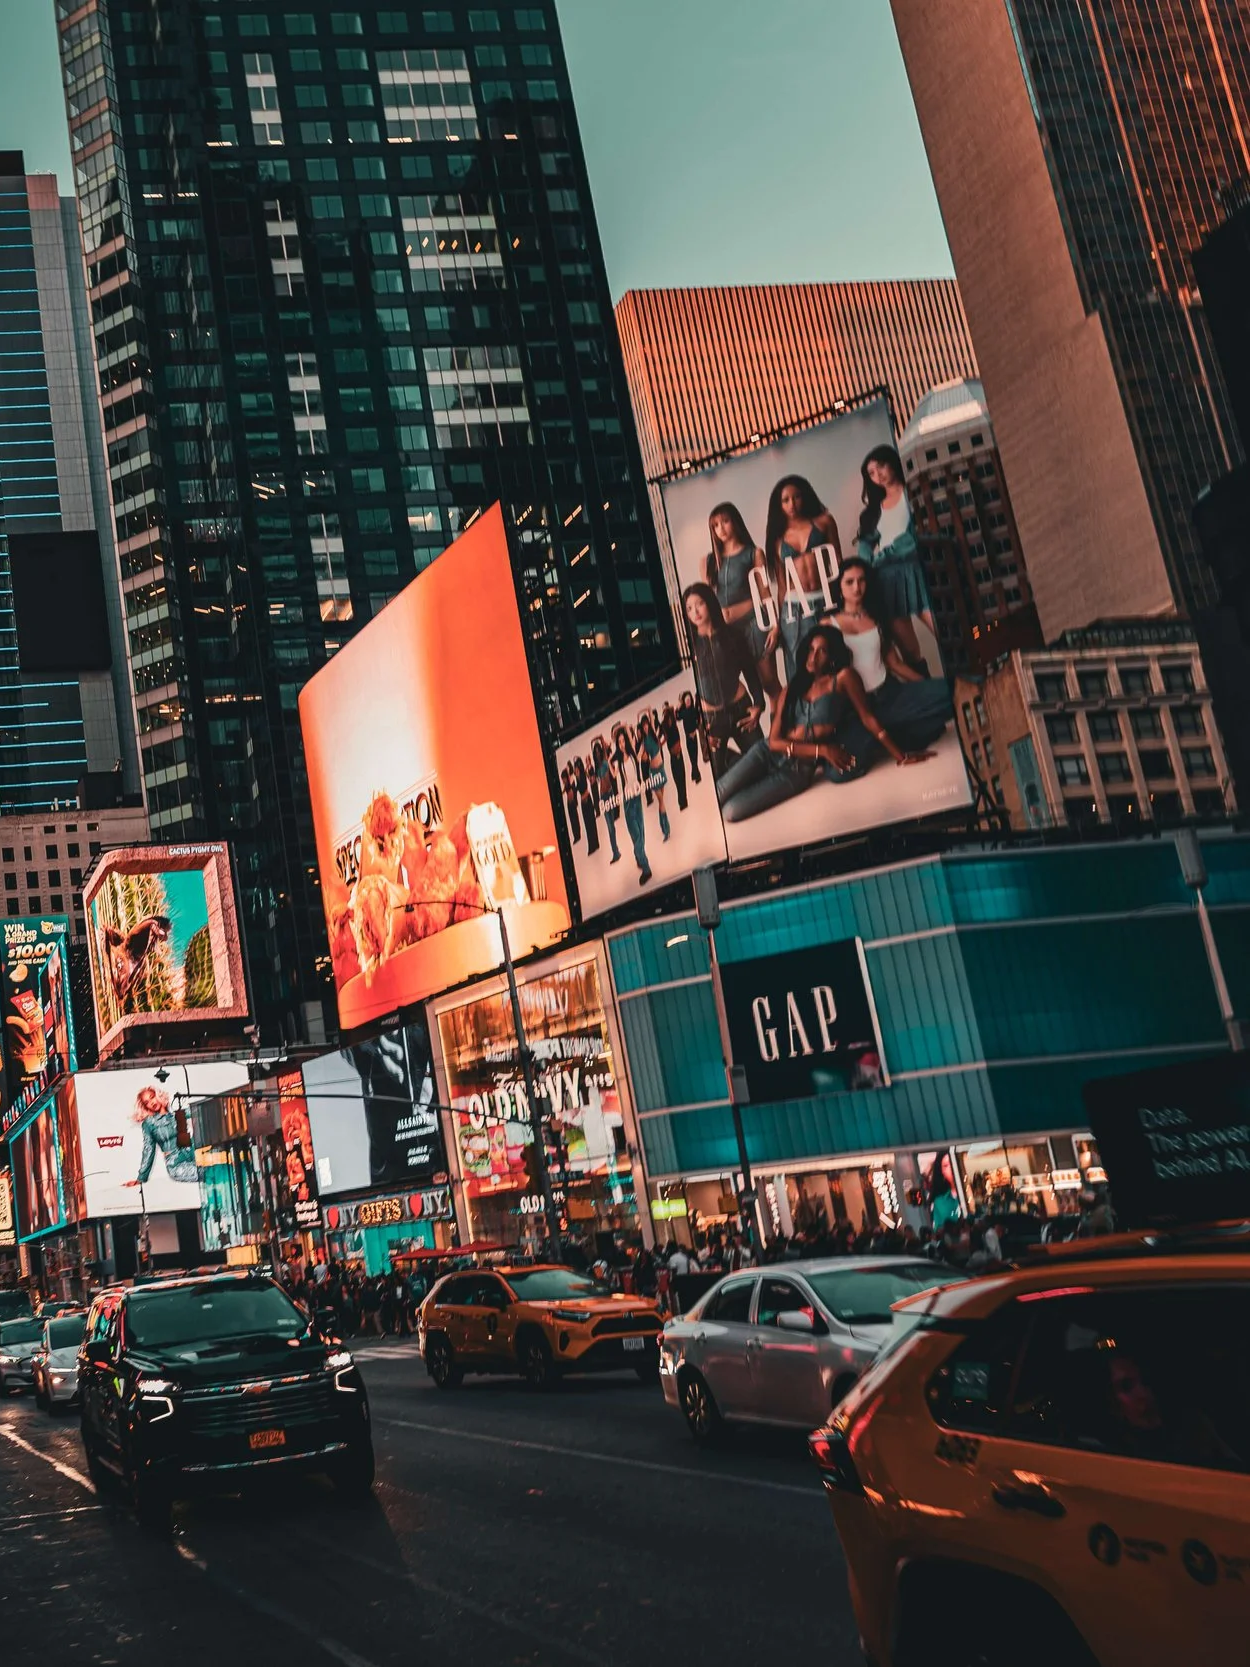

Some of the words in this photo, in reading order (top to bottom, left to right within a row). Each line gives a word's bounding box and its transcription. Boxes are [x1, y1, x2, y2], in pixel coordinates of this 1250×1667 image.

[748, 543, 840, 632] GAP
[169, 847, 190, 856] CACTUS
[211, 844, 224, 853] OWL
[4, 923, 25, 933] WIN
[12, 930, 37, 939] GRAND
[5, 937, 25, 945] PRIZE
[752, 985, 838, 1062] GAP
[470, 1087, 511, 1130] OLD
[360, 1198, 402, 1225] GIFTS
